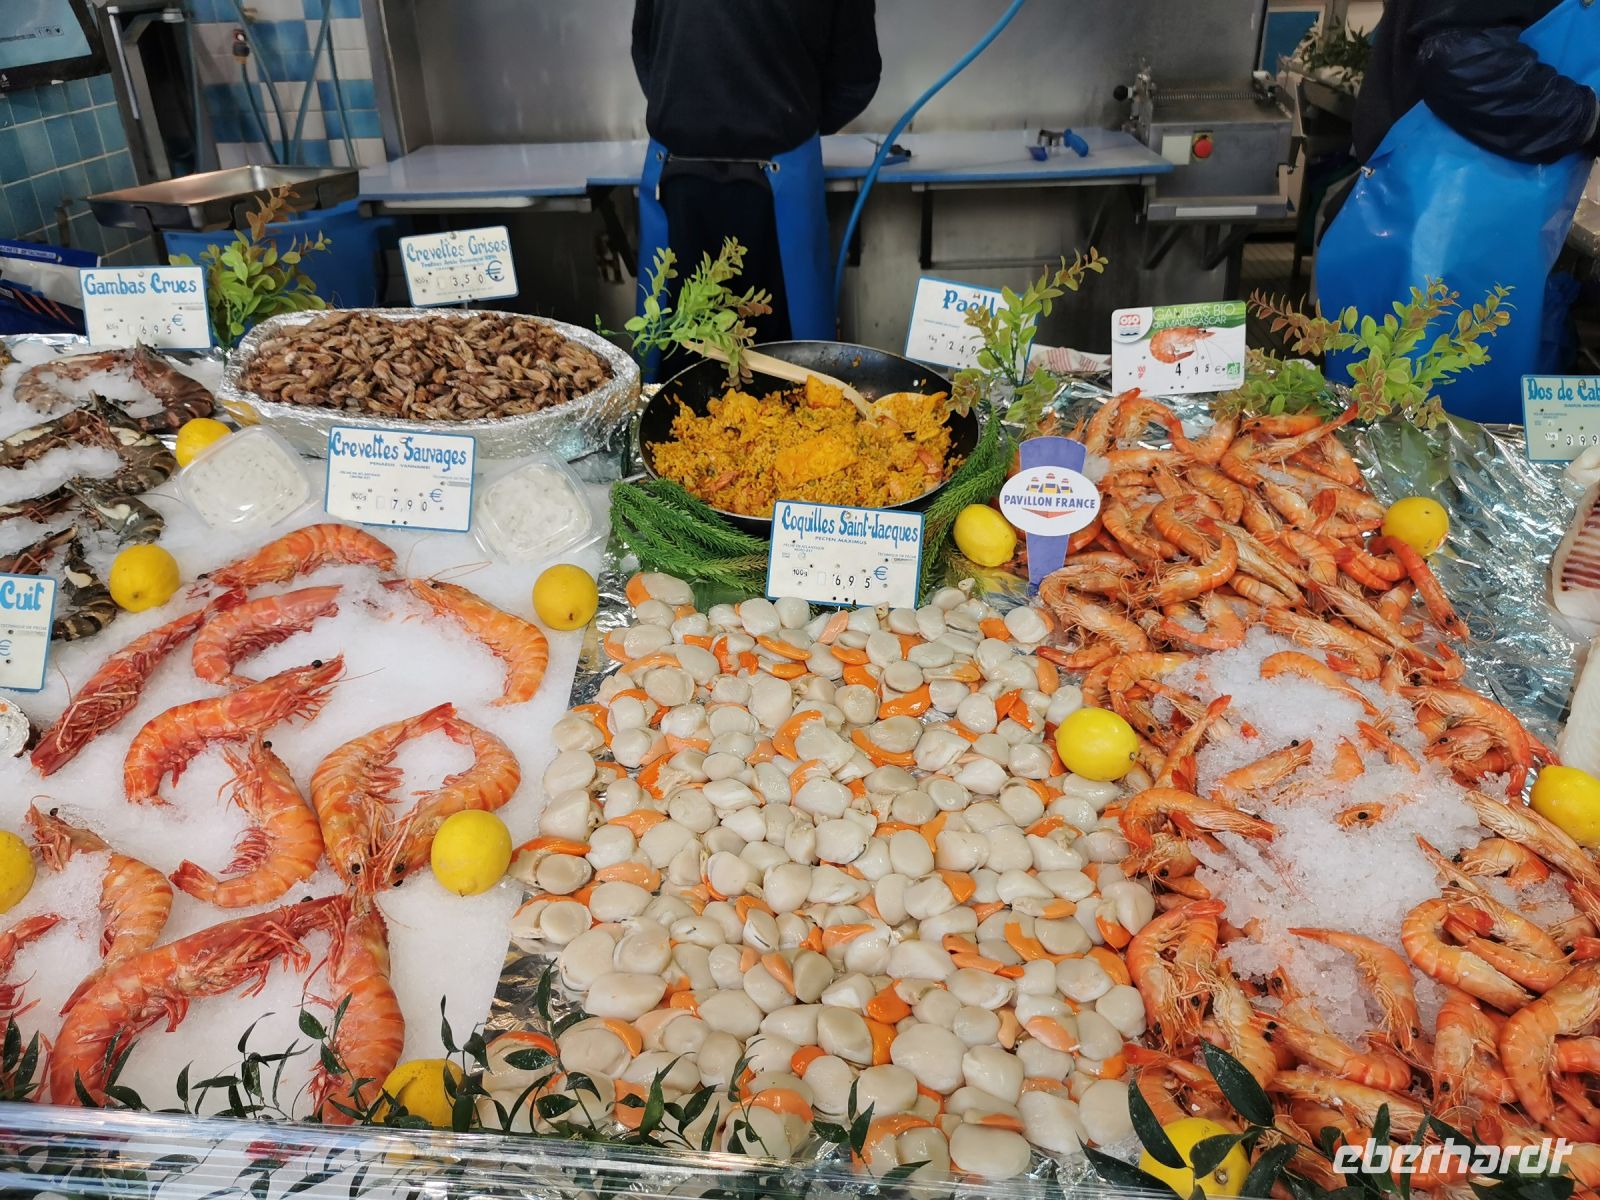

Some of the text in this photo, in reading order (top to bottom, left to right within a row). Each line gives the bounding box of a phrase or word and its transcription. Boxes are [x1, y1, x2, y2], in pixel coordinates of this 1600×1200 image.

[468, 235, 508, 255] Grises
[84, 272, 197, 295] Gambas Crues
[1153, 303, 1236, 321] GAMBAS BIO
[1166, 315, 1227, 329] MADAGASCAR
[1526, 378, 1553, 401] Dos
[1557, 378, 1574, 401] de
[329, 431, 467, 472] Crevettes Sauvages
[1055, 497, 1096, 509] FRANCE
[781, 505, 918, 549] Coquilles Saint-Jacques
[873, 566, 889, 581] €
[0, 580, 45, 611] Cuit
